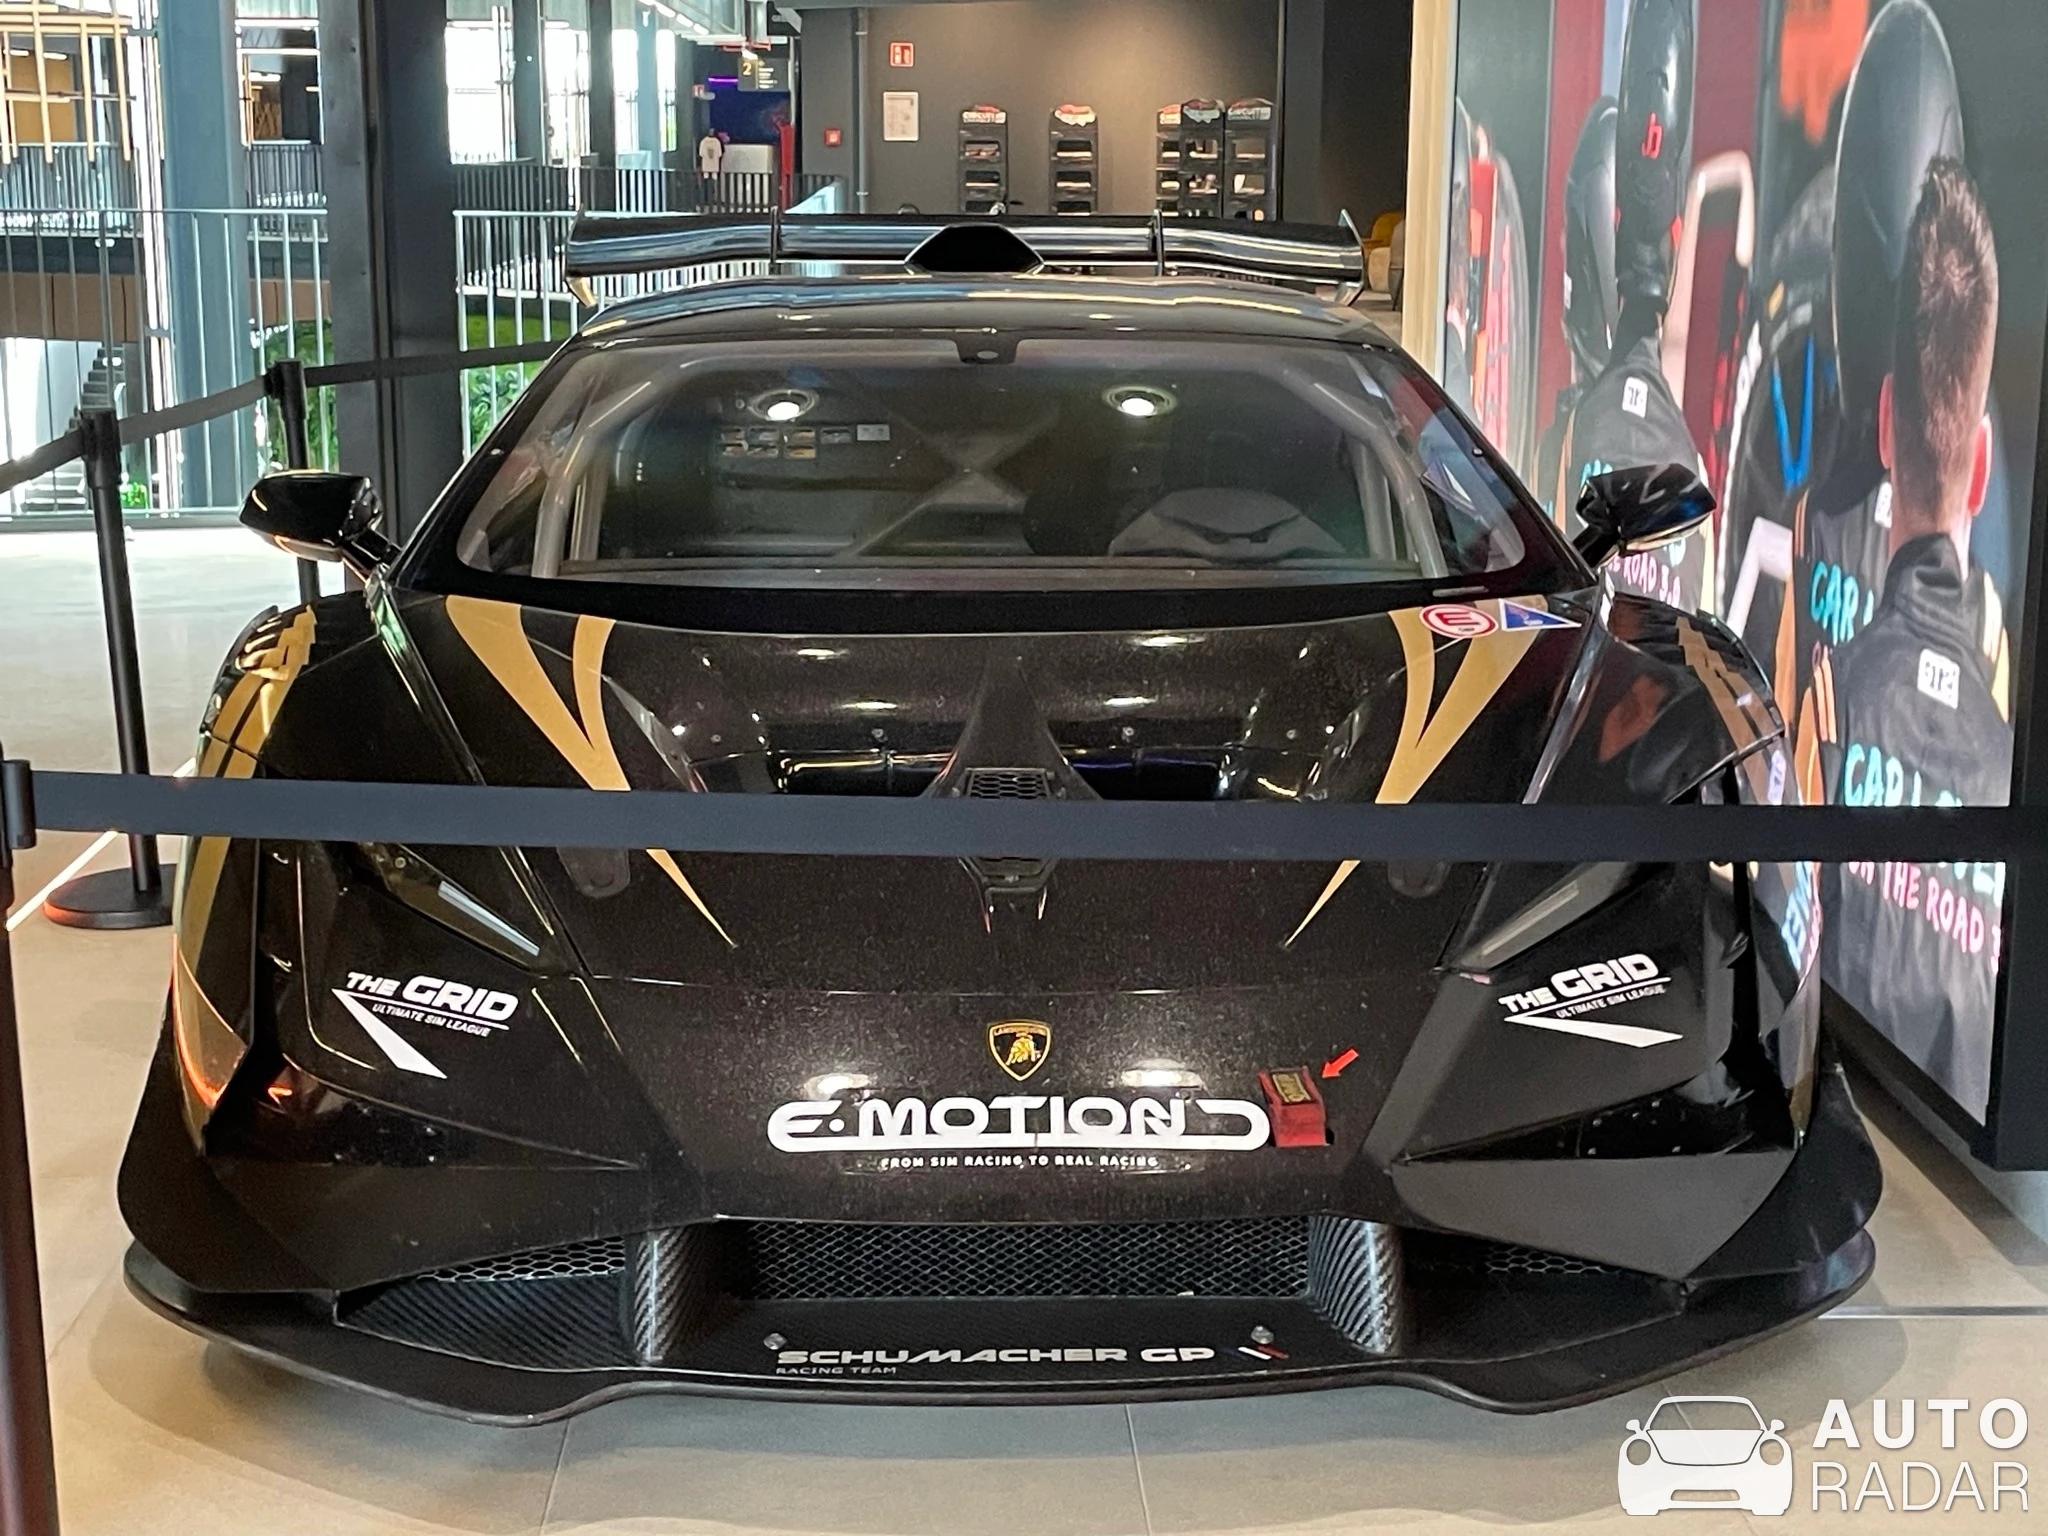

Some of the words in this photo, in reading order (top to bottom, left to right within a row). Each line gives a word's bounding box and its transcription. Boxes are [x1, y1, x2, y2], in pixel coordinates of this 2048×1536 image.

[742, 61, 752, 76] 2
[1623, 552, 1657, 594] ROAD
[1811, 560, 1859, 647] CAR
[1882, 861, 1921, 909] THE
[1926, 876, 1985, 953] ROAD
[346, 971, 401, 997] THE
[402, 975, 519, 1021] GRID
[1498, 986, 1557, 1013] THE
[1551, 953, 1660, 998] GRID
[1555, 998, 1607, 1019] ULTIMATE
[1607, 993, 1627, 1006] SIM
[1627, 983, 1667, 1002] LEAGUE
[372, 1003, 425, 1022] ULTIMATE
[424, 1014, 445, 1027] SIM
[446, 1018, 492, 1038] LEAGUE
[881, 1157, 924, 1169] FROM
[930, 1156, 958, 1167] SIM
[964, 1155, 1021, 1167] RACING
[1028, 1155, 1049, 1166] TO
[1054, 1155, 1093, 1167] REAL
[1099, 1155, 1159, 1168] RACING
[776, 1366, 844, 1375] RACING
[851, 1366, 897, 1374] TEAM
[777, 1348, 1128, 1364] SCHUMACHER
[1140, 1347, 1216, 1363] GP
